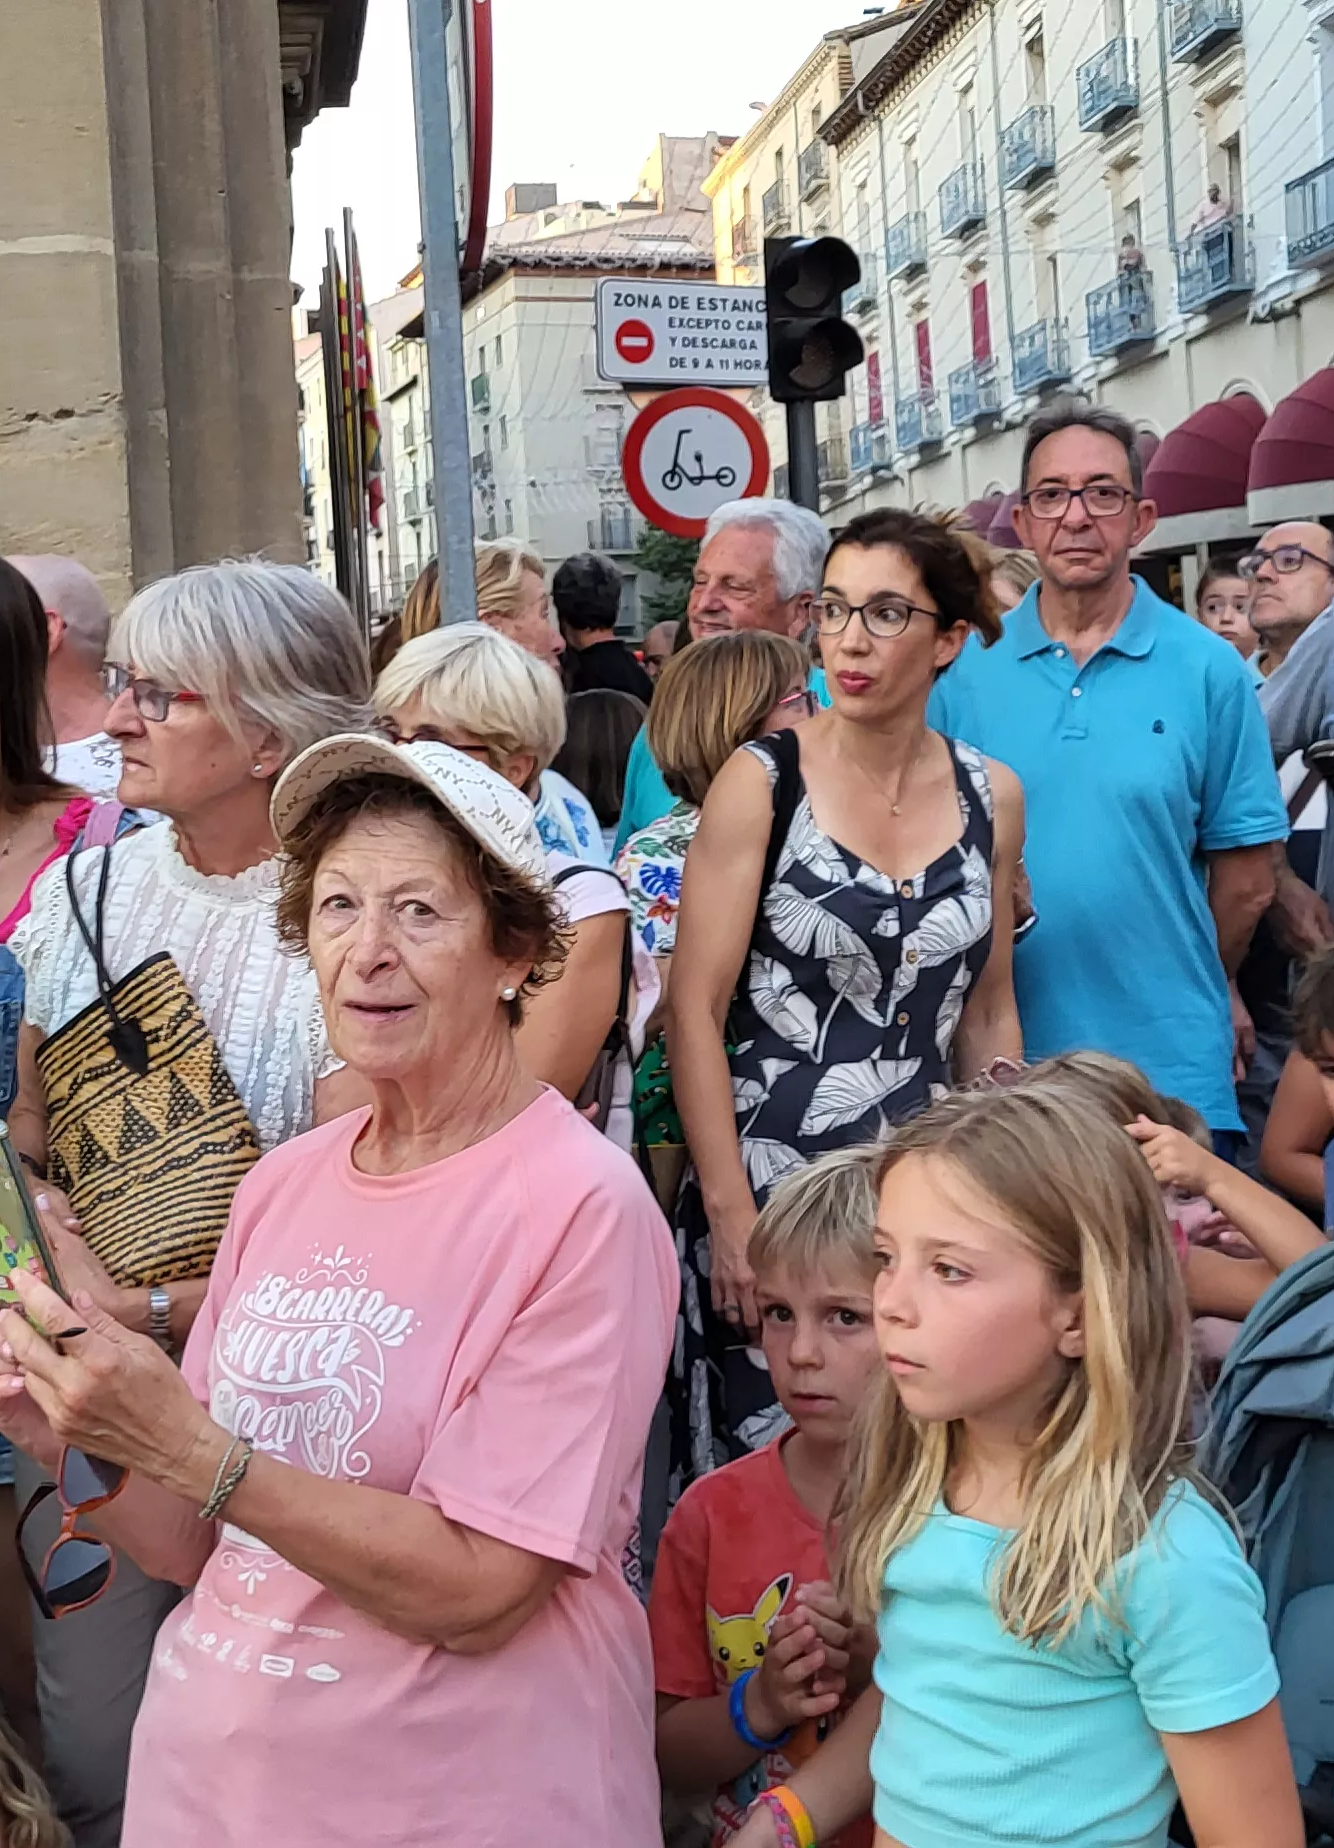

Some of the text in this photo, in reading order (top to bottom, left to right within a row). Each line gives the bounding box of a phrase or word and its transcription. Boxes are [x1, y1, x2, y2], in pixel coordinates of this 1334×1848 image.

[613, 293, 662, 309] ZONA
[668, 296, 690, 310] DE
[668, 317, 768, 331] EXCEPTO CAR
[669, 336, 758, 350] Y DESCARGA
[669, 357, 687, 369] DE
[692, 358, 699, 369] 9
[705, 358, 714, 370] A
[720, 359, 729, 371] 11
[225, 1320, 355, 1383] HUESCA
